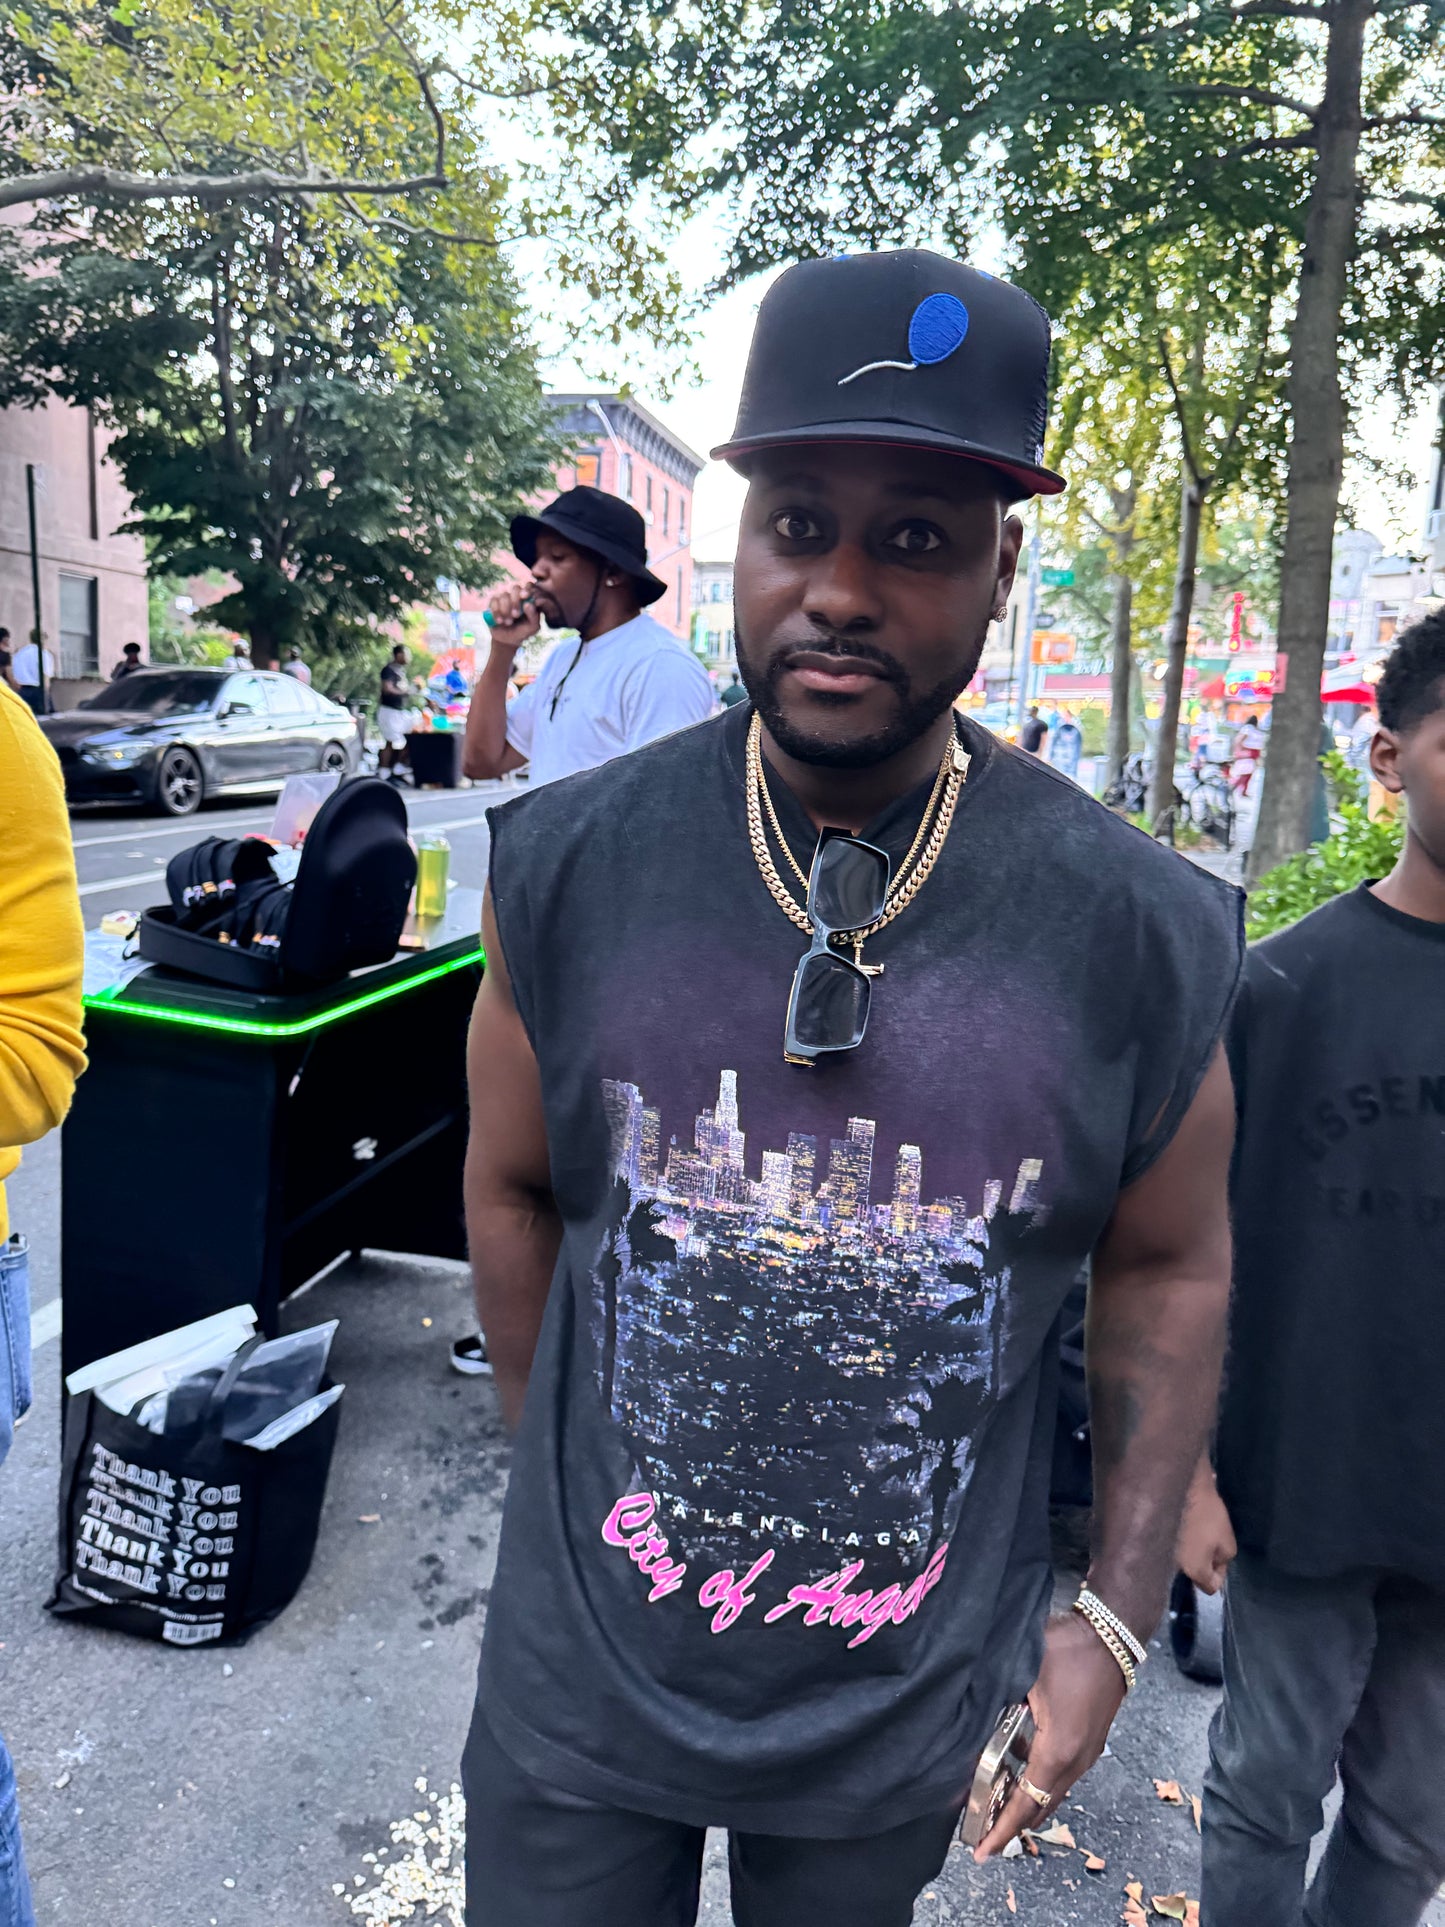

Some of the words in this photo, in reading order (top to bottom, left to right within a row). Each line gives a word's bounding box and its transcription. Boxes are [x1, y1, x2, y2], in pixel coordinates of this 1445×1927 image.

[89, 1467, 175, 1521] Thank
[178, 1502, 238, 1531] You
[92, 1442, 177, 1498] Thank
[181, 1477, 241, 1506] You
[80, 1514, 165, 1568] Thank
[172, 1548, 229, 1578] You
[86, 1488, 171, 1544] Thank
[175, 1525, 234, 1555] You
[652, 1490, 921, 1546] BALENCIAGA
[75, 1539, 162, 1595] Thank
[166, 1573, 226, 1601] You
[602, 1491, 687, 1603] City
[698, 1549, 775, 1634] of
